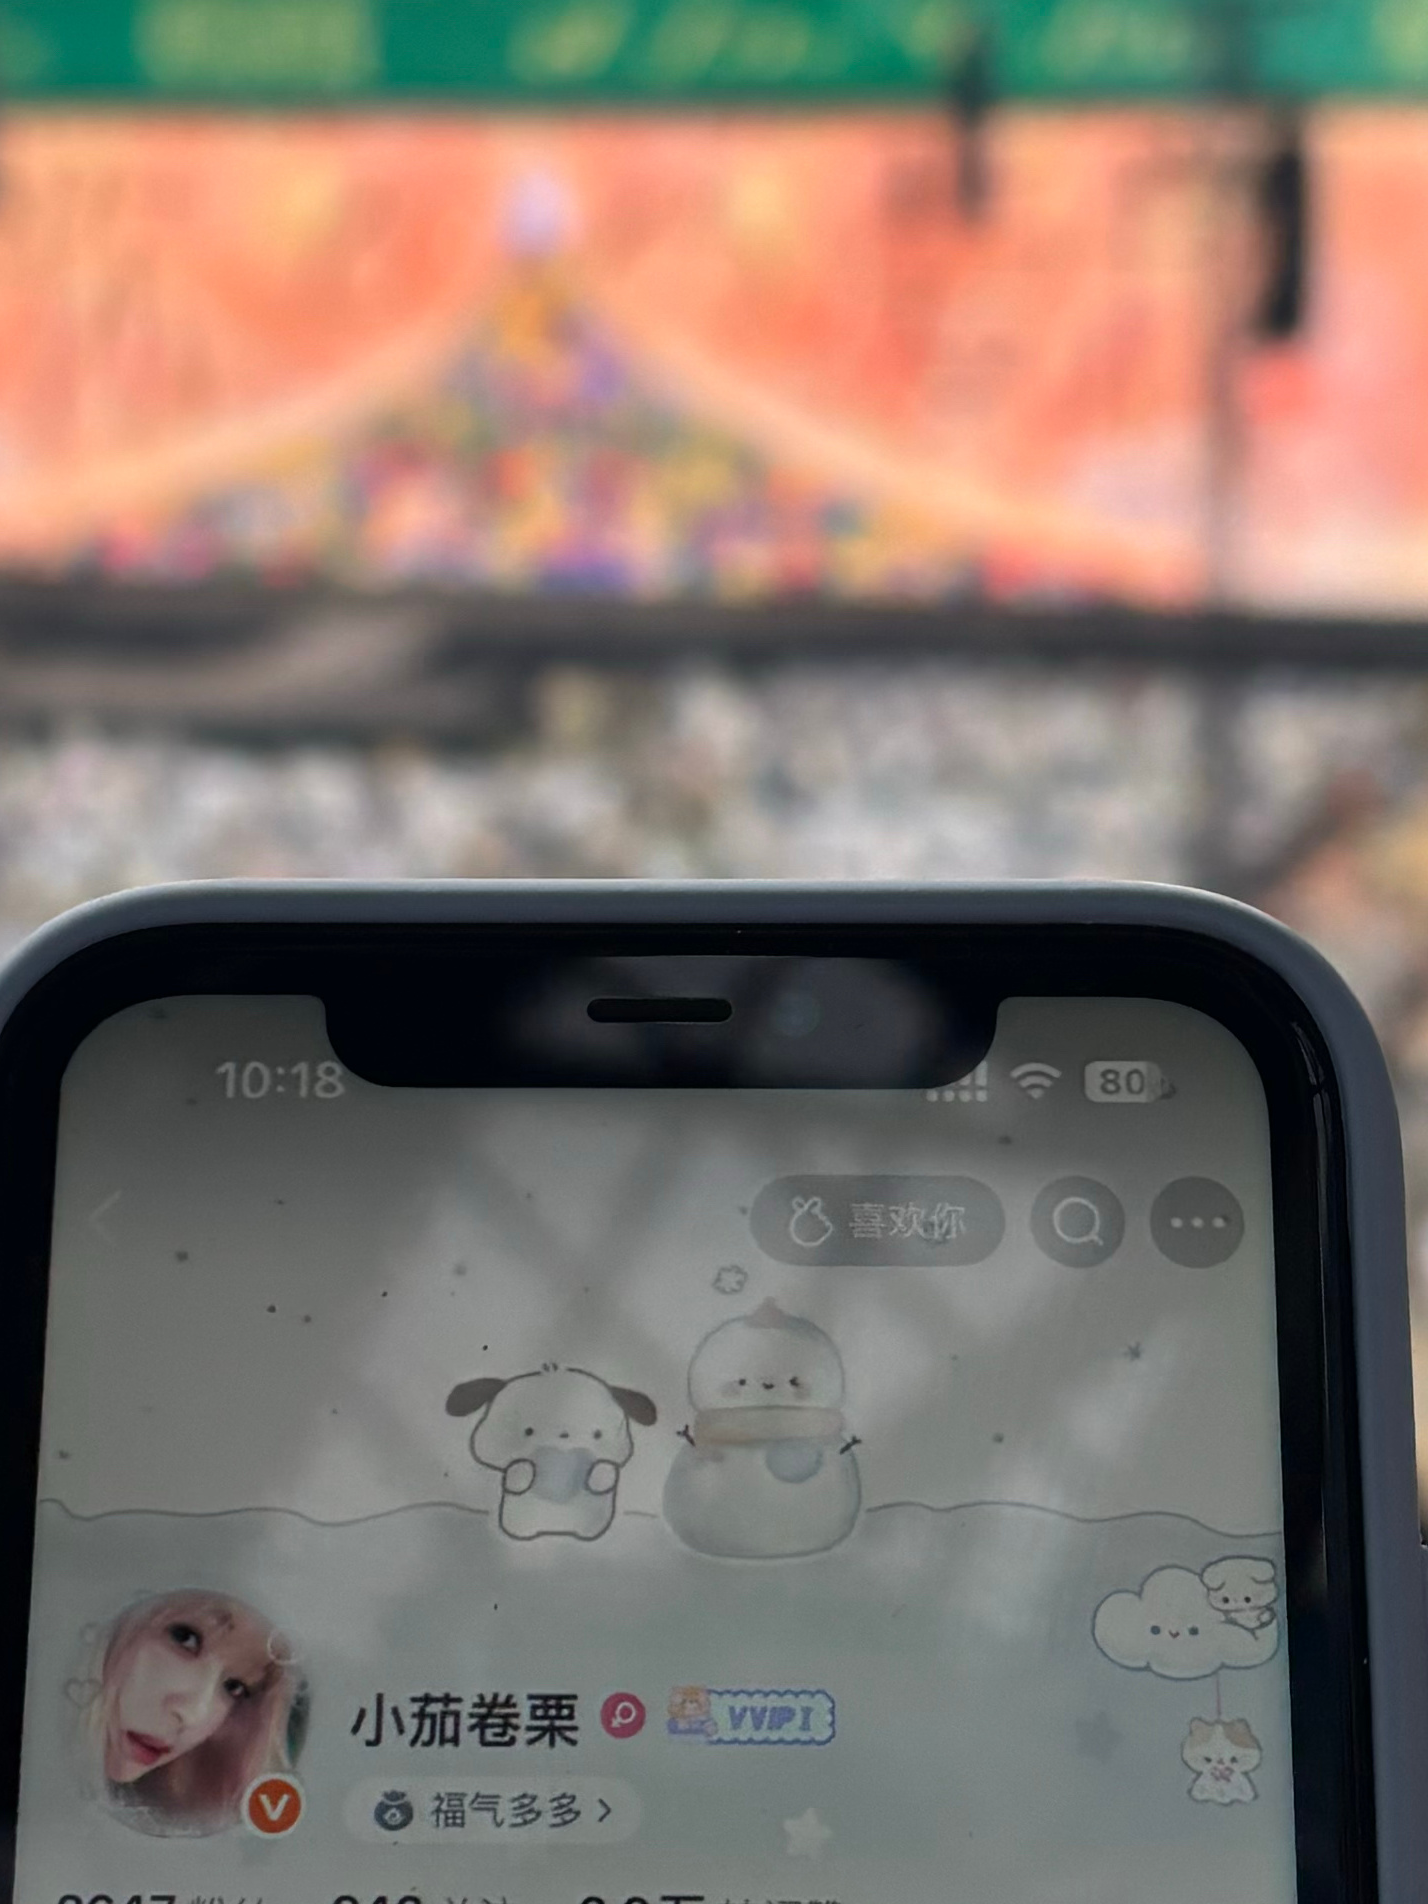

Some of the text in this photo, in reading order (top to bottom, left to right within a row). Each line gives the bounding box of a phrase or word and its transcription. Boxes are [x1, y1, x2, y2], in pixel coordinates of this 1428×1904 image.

[215, 1060, 346, 1099] 10:18
[1100, 1069, 1144, 1095] 80
[350, 1691, 580, 1749] 小茄卷栗
[430, 1791, 582, 1829] 福气多多
